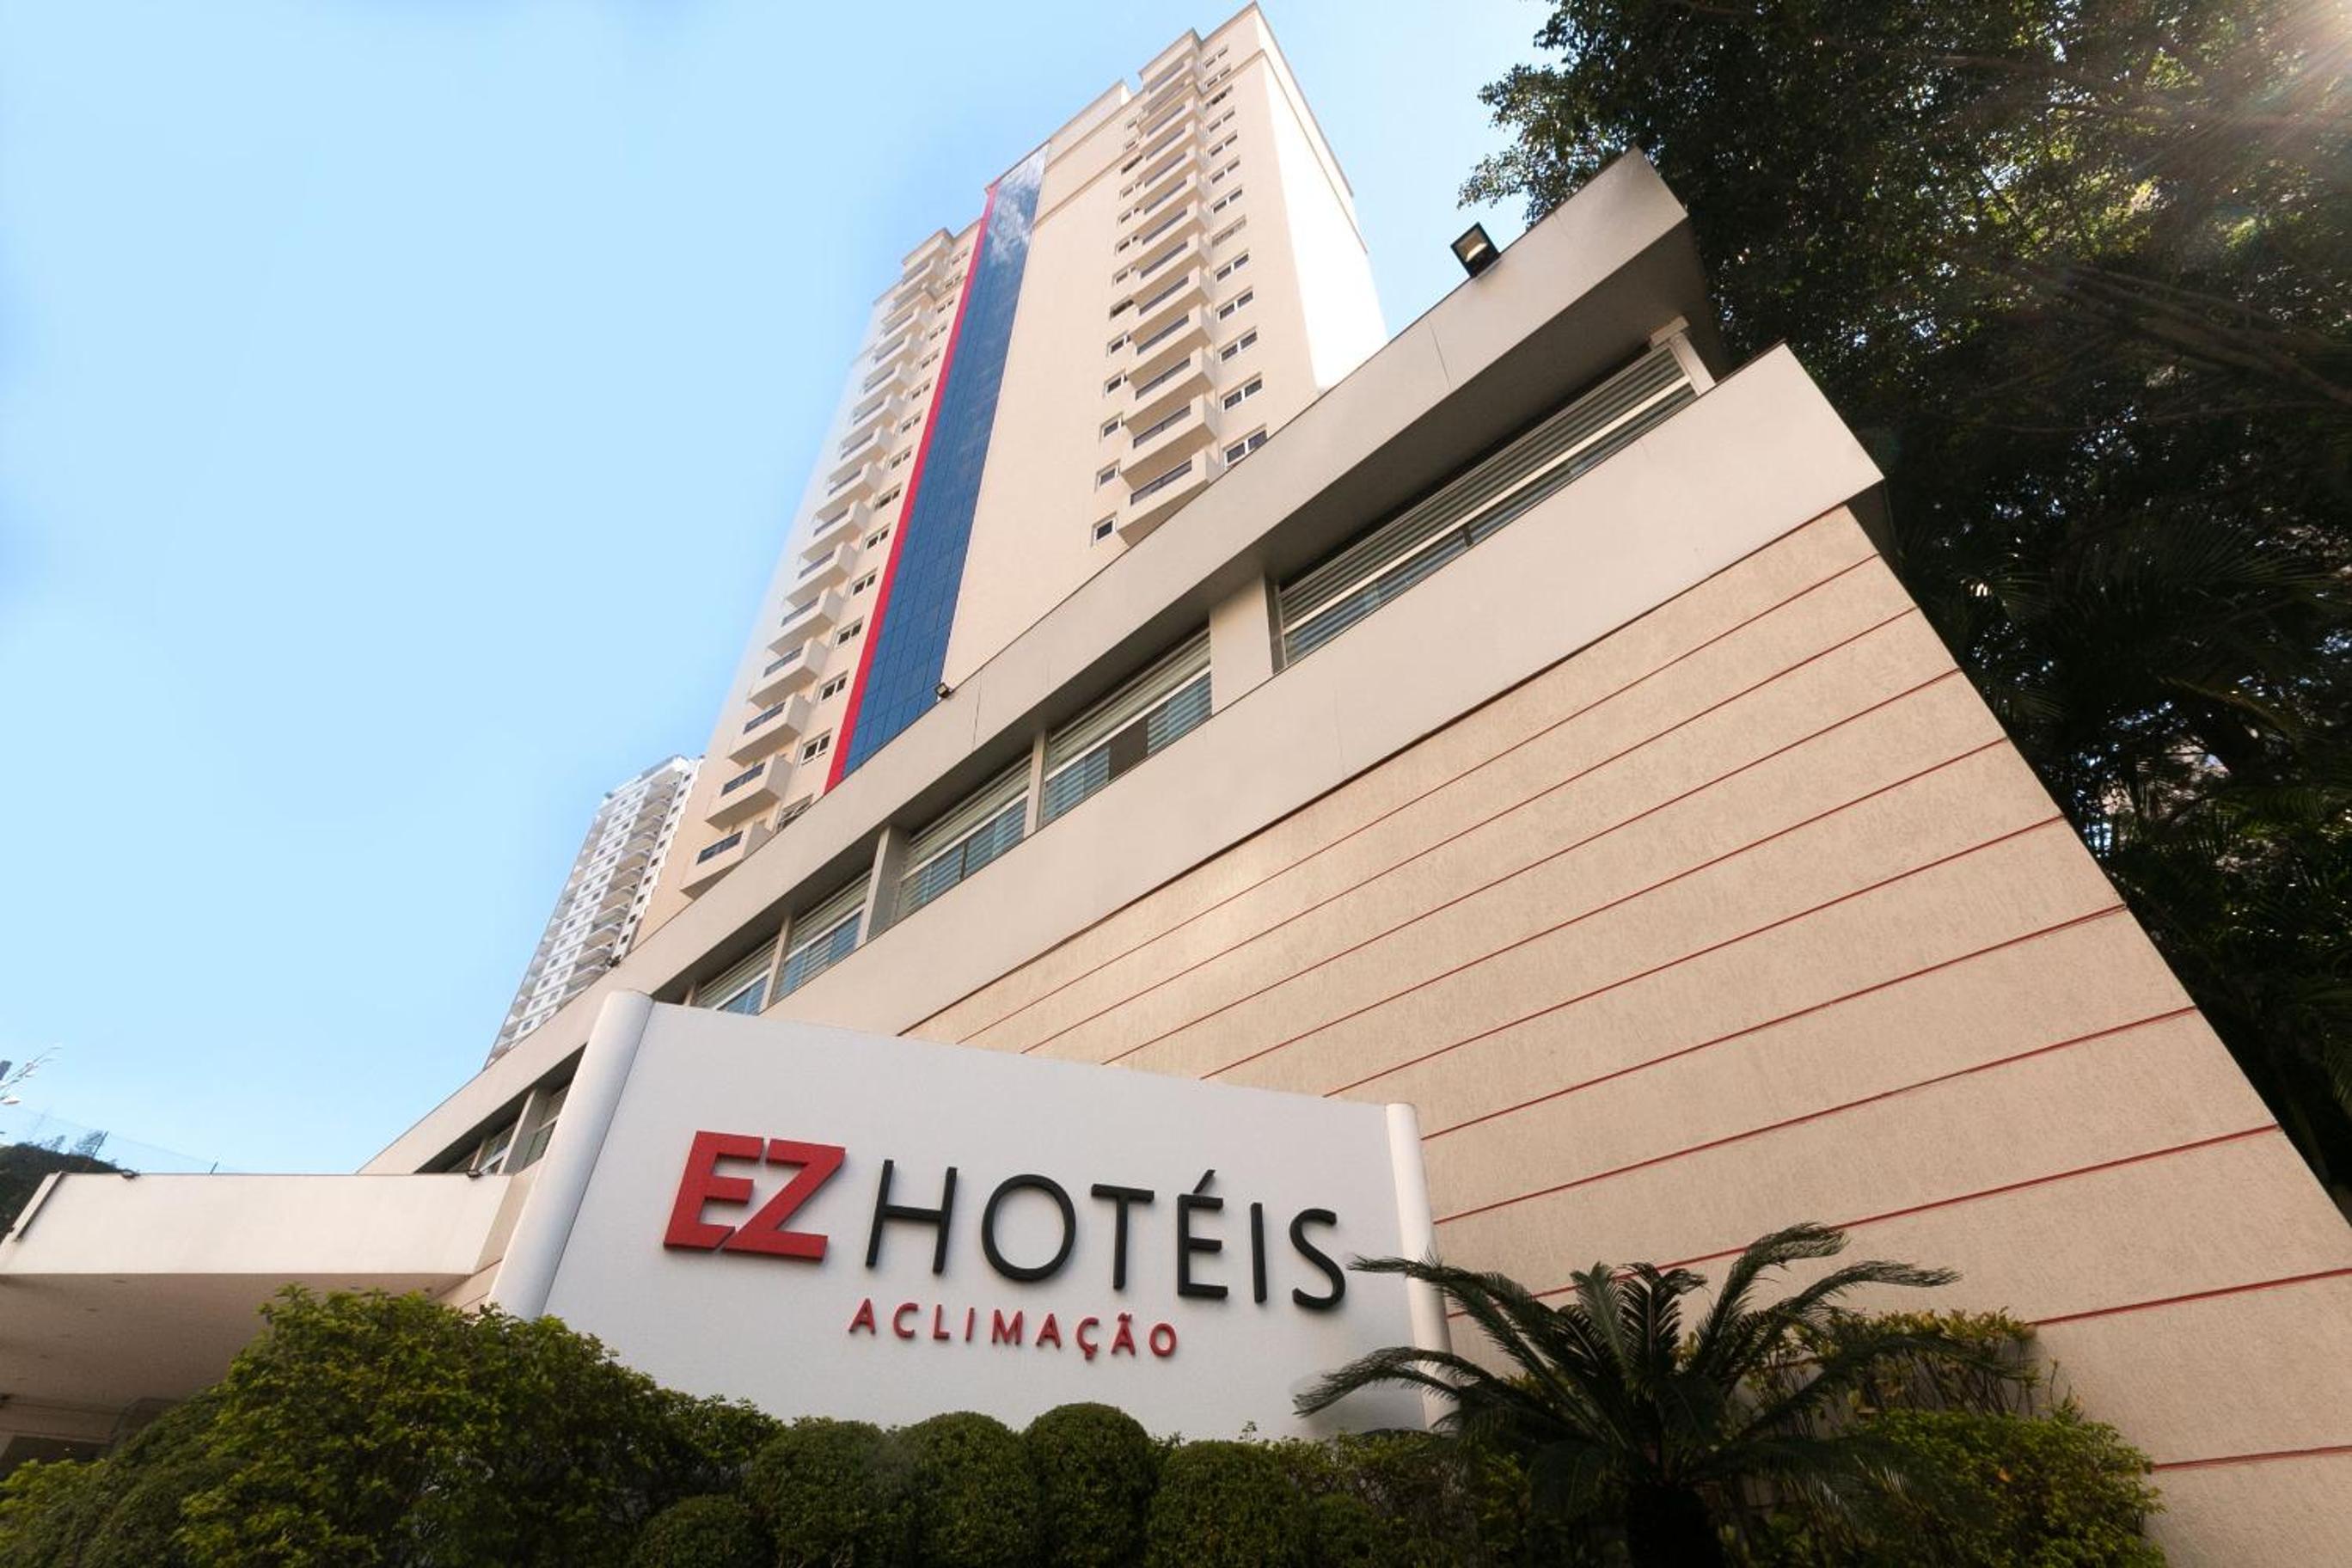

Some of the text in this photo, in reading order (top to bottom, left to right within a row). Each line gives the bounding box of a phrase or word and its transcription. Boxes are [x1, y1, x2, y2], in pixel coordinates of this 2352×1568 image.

[664, 1130, 1347, 1310] EZ HOTÉIS
[848, 1298, 1179, 1361] ACLIMAÇÃO
